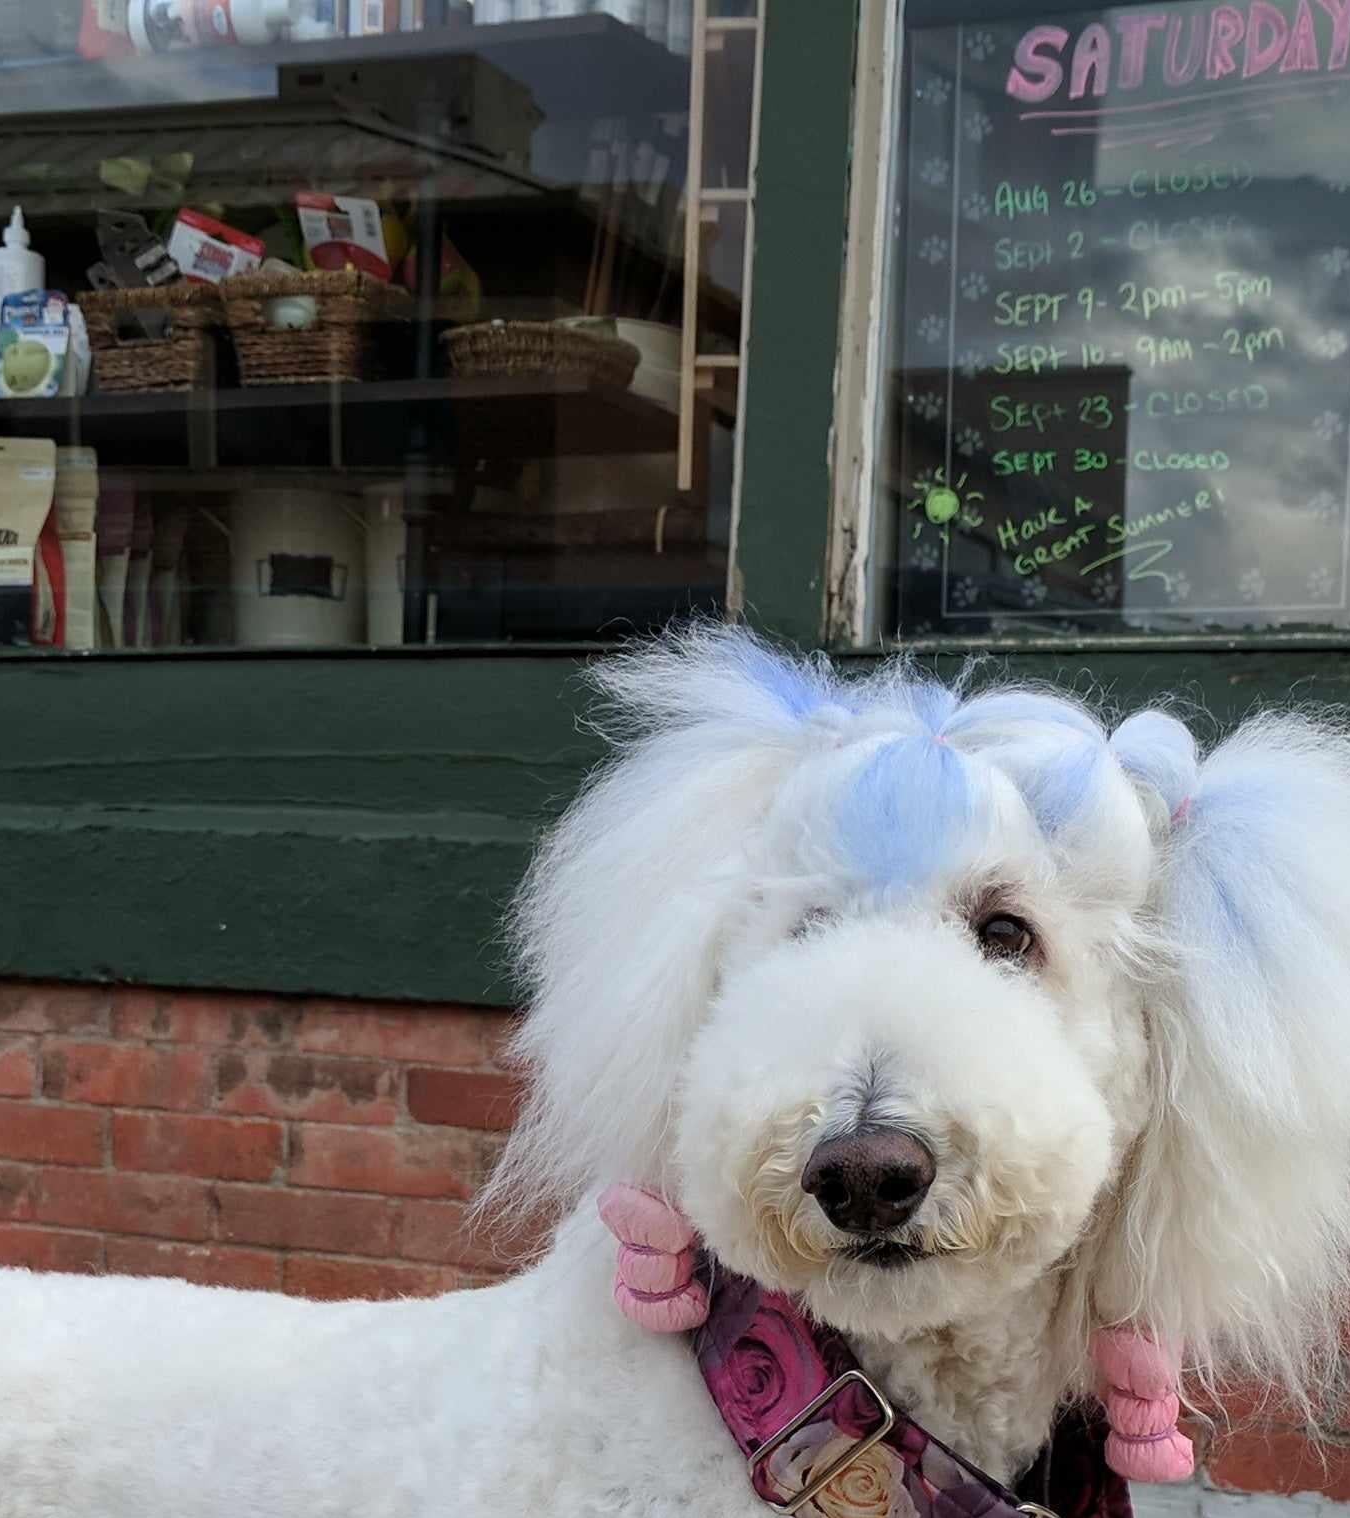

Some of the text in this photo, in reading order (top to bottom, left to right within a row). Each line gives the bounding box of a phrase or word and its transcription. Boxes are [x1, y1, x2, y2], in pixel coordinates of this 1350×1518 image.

[994, 181, 1049, 220] AUG
[1061, 179, 1097, 207] 26
[1128, 160, 1253, 198] CLOSED
[1067, 231, 1084, 260] 2
[994, 290, 1067, 327] SEPT
[1118, 281, 1188, 321] 2pm
[1216, 271, 1273, 305] 5pm
[1223, 327, 1285, 361] 2pm
[1078, 395, 1113, 429] 23
[1147, 385, 1269, 418] CLOSED
[992, 449, 1057, 476] SEPT
[1074, 448, 1108, 471] 30
[1134, 450, 1231, 471] CLOSED
[1074, 496, 1093, 516] A
[1014, 524, 1096, 577] GREAT
